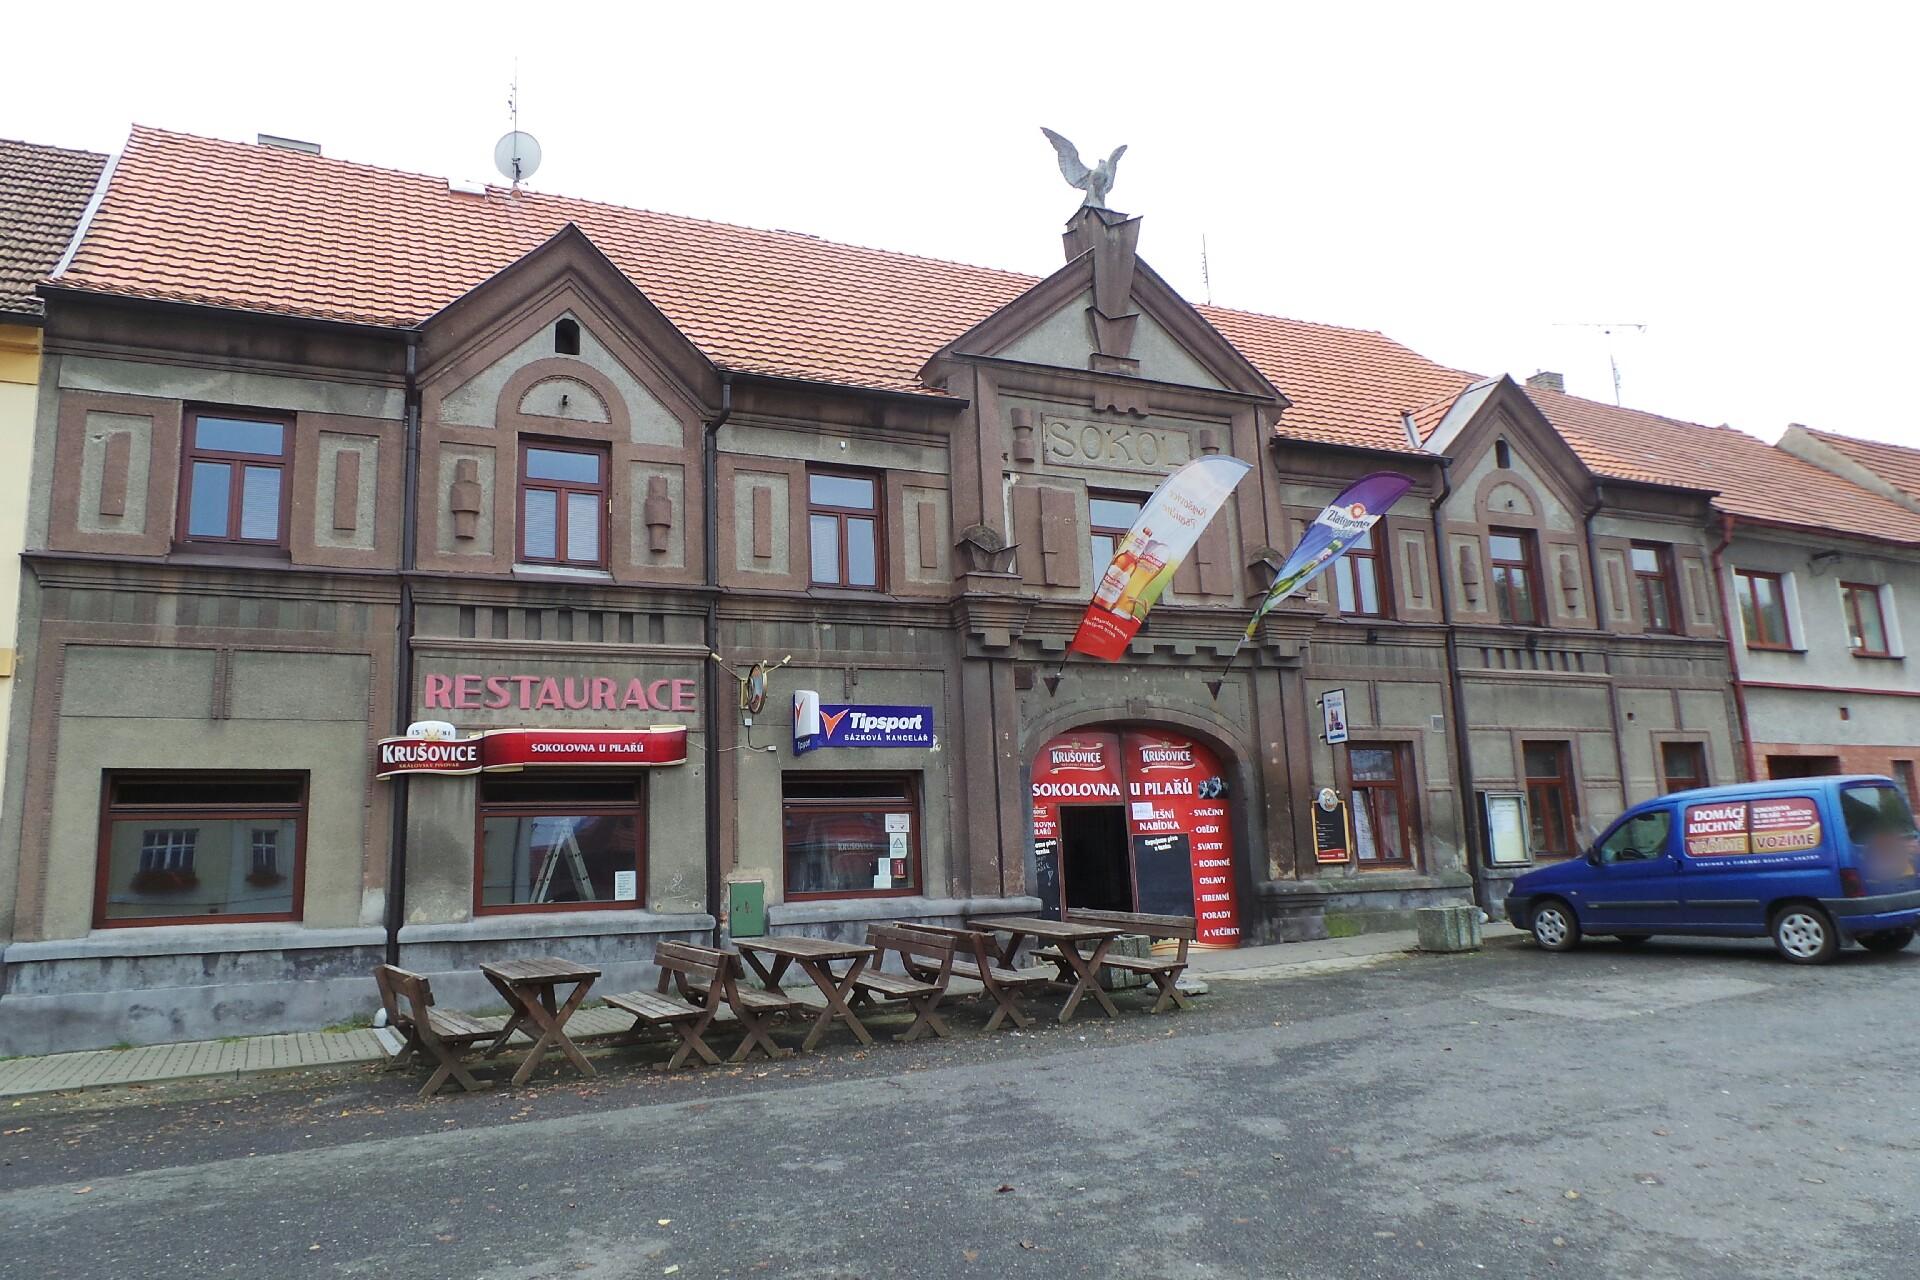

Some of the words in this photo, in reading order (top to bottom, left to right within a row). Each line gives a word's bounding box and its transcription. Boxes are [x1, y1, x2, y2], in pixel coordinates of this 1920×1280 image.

[424, 674, 697, 711] RESTAURACE
[850, 712, 922, 733] Tipsport
[844, 733, 882, 741] SÁZKOVÁ
[886, 733, 928, 742] KANCELÁŘ
[531, 743, 595, 752] SOKOLOVNA
[599, 744, 606, 752] U
[382, 743, 477, 763] KRUŠOVICE
[1052, 749, 1101, 763] KRUŠOVICE
[1142, 749, 1191, 763] KRUŠOVICE
[1032, 782, 1121, 796] SOKOLOVNA
[1129, 782, 1140, 796] U
[1144, 778, 1193, 796] PILAŘŮ
[1152, 809, 1174, 819] NEŠNÍ
[1193, 808, 1224, 817] SVAČINY
[1694, 805, 1746, 820] DOMÁCÍ
[1139, 820, 1180, 831] NABÍDKA
[1195, 825, 1219, 833] OBĚDY
[1756, 833, 1815, 848] VOZÍME
[1199, 858, 1230, 867] RODINNÉ
[1200, 876, 1226, 884] OSLAVY
[1202, 911, 1231, 919] PORADY
[1211, 927, 1240, 936] VEČÍRKY
